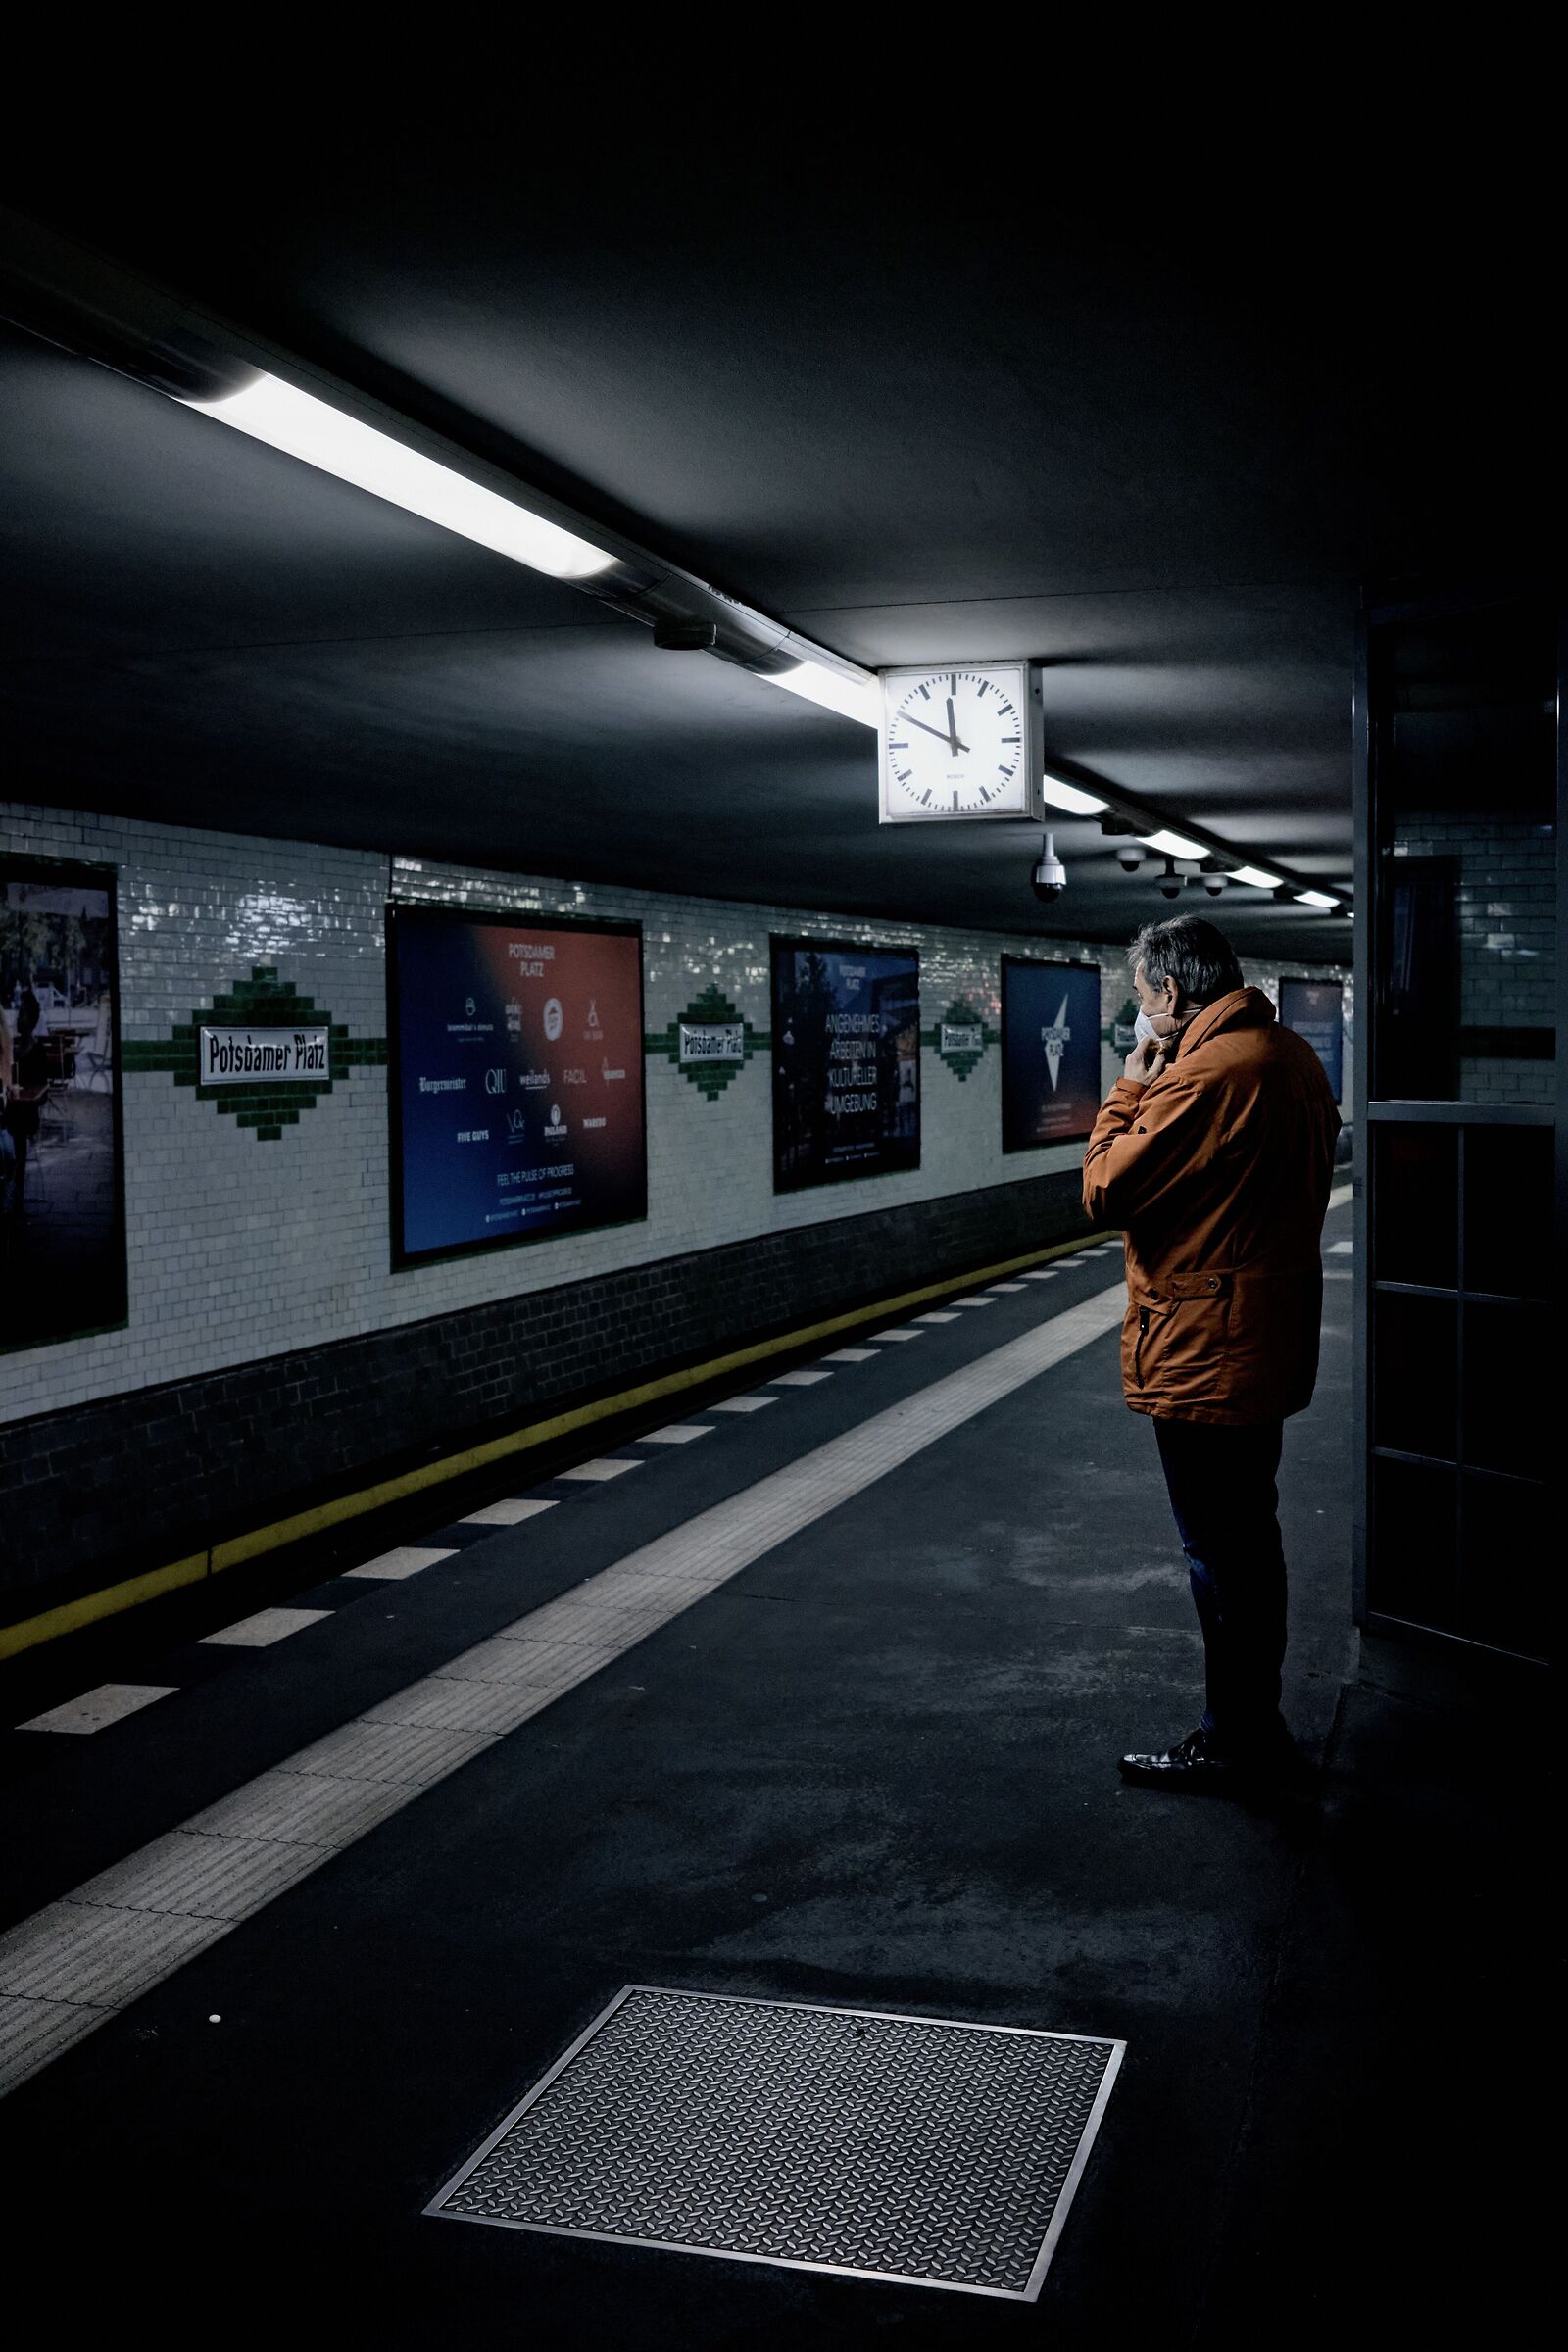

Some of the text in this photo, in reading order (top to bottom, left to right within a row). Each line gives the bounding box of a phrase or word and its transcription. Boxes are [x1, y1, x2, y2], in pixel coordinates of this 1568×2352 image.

[508, 943, 556, 960] POTSDAMER
[520, 962, 545, 977] PLATZ
[825, 1012, 880, 1035] ANGENEHMES
[209, 1034, 325, 1074] Potsdamer Platz
[830, 1040, 877, 1059] ARBEITEN IN
[485, 1068, 507, 1095] QIU
[564, 1069, 587, 1084] FACIL
[829, 1065, 878, 1088] KULTURELLER
[831, 1091, 878, 1115] UMGEBUNG
[457, 1129, 489, 1143] FIVE GUYS
[497, 1163, 574, 1187] FEEL THE PULSE OF PROGRESS
